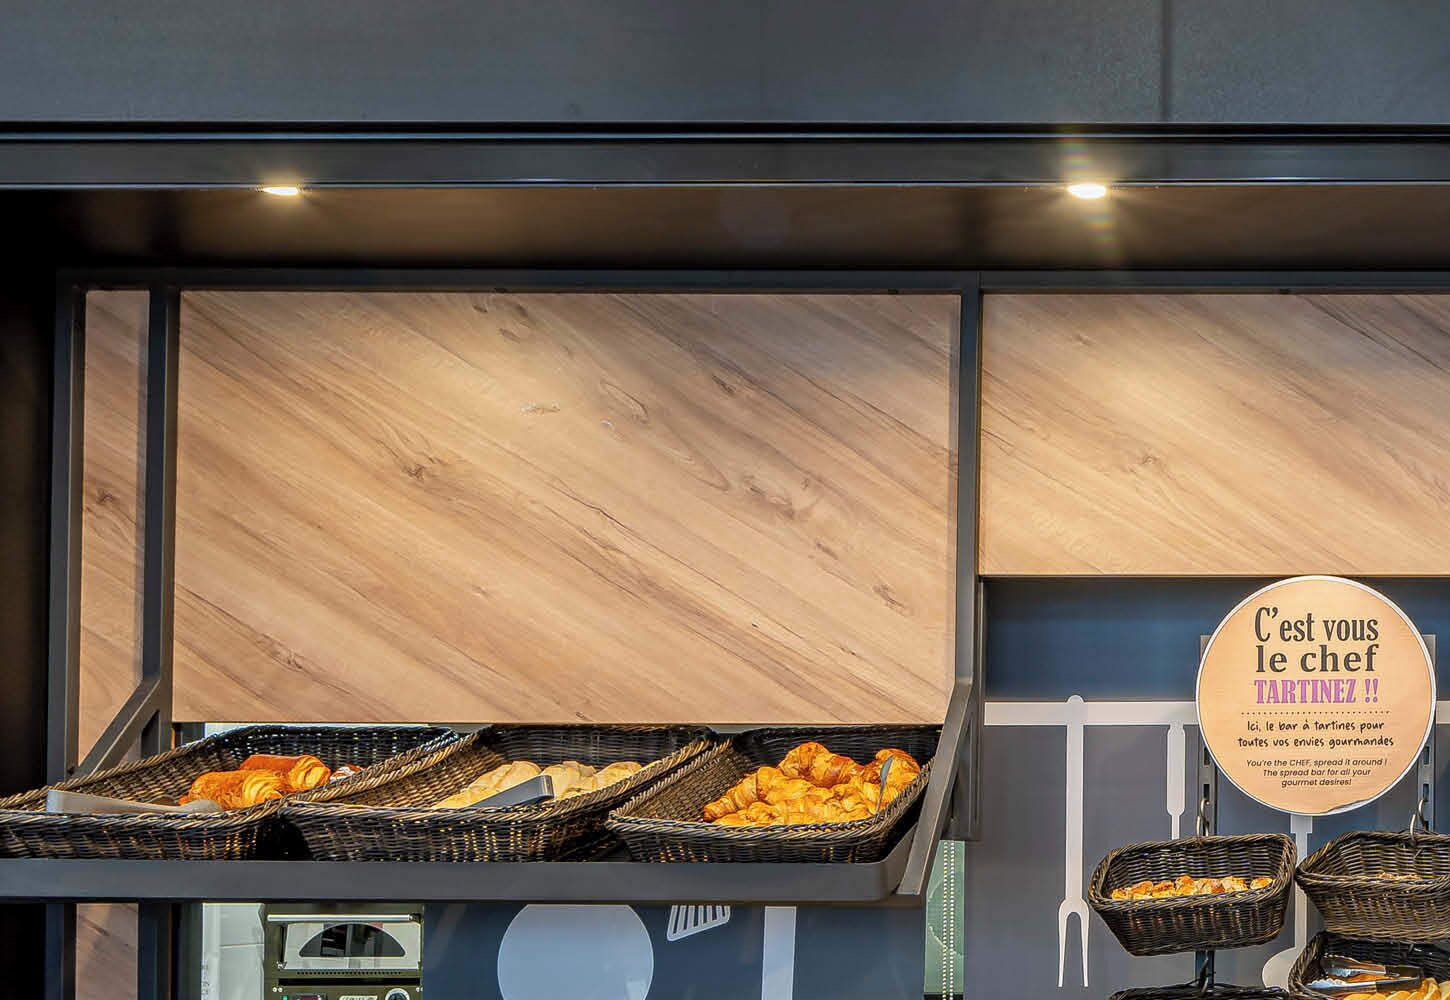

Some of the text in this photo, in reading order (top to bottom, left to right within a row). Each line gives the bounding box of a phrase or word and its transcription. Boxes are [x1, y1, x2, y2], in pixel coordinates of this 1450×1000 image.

[1323, 618, 1380, 642] vous
[1255, 644, 1380, 673] le chef
[1254, 678, 1380, 704] TARTINEZ !!
[1247, 719, 1385, 734] Ici, le bar à tartines pour
[1238, 736, 1394, 749] toutes vos envies gourmandes
[1246, 758, 1272, 767] You're
[1273, 759, 1288, 767] the
[1313, 758, 1343, 768] spread
[1352, 758, 1383, 766] around
[1263, 768, 1371, 778] The spread bar for all your
[1281, 779, 1318, 788] gourmet
